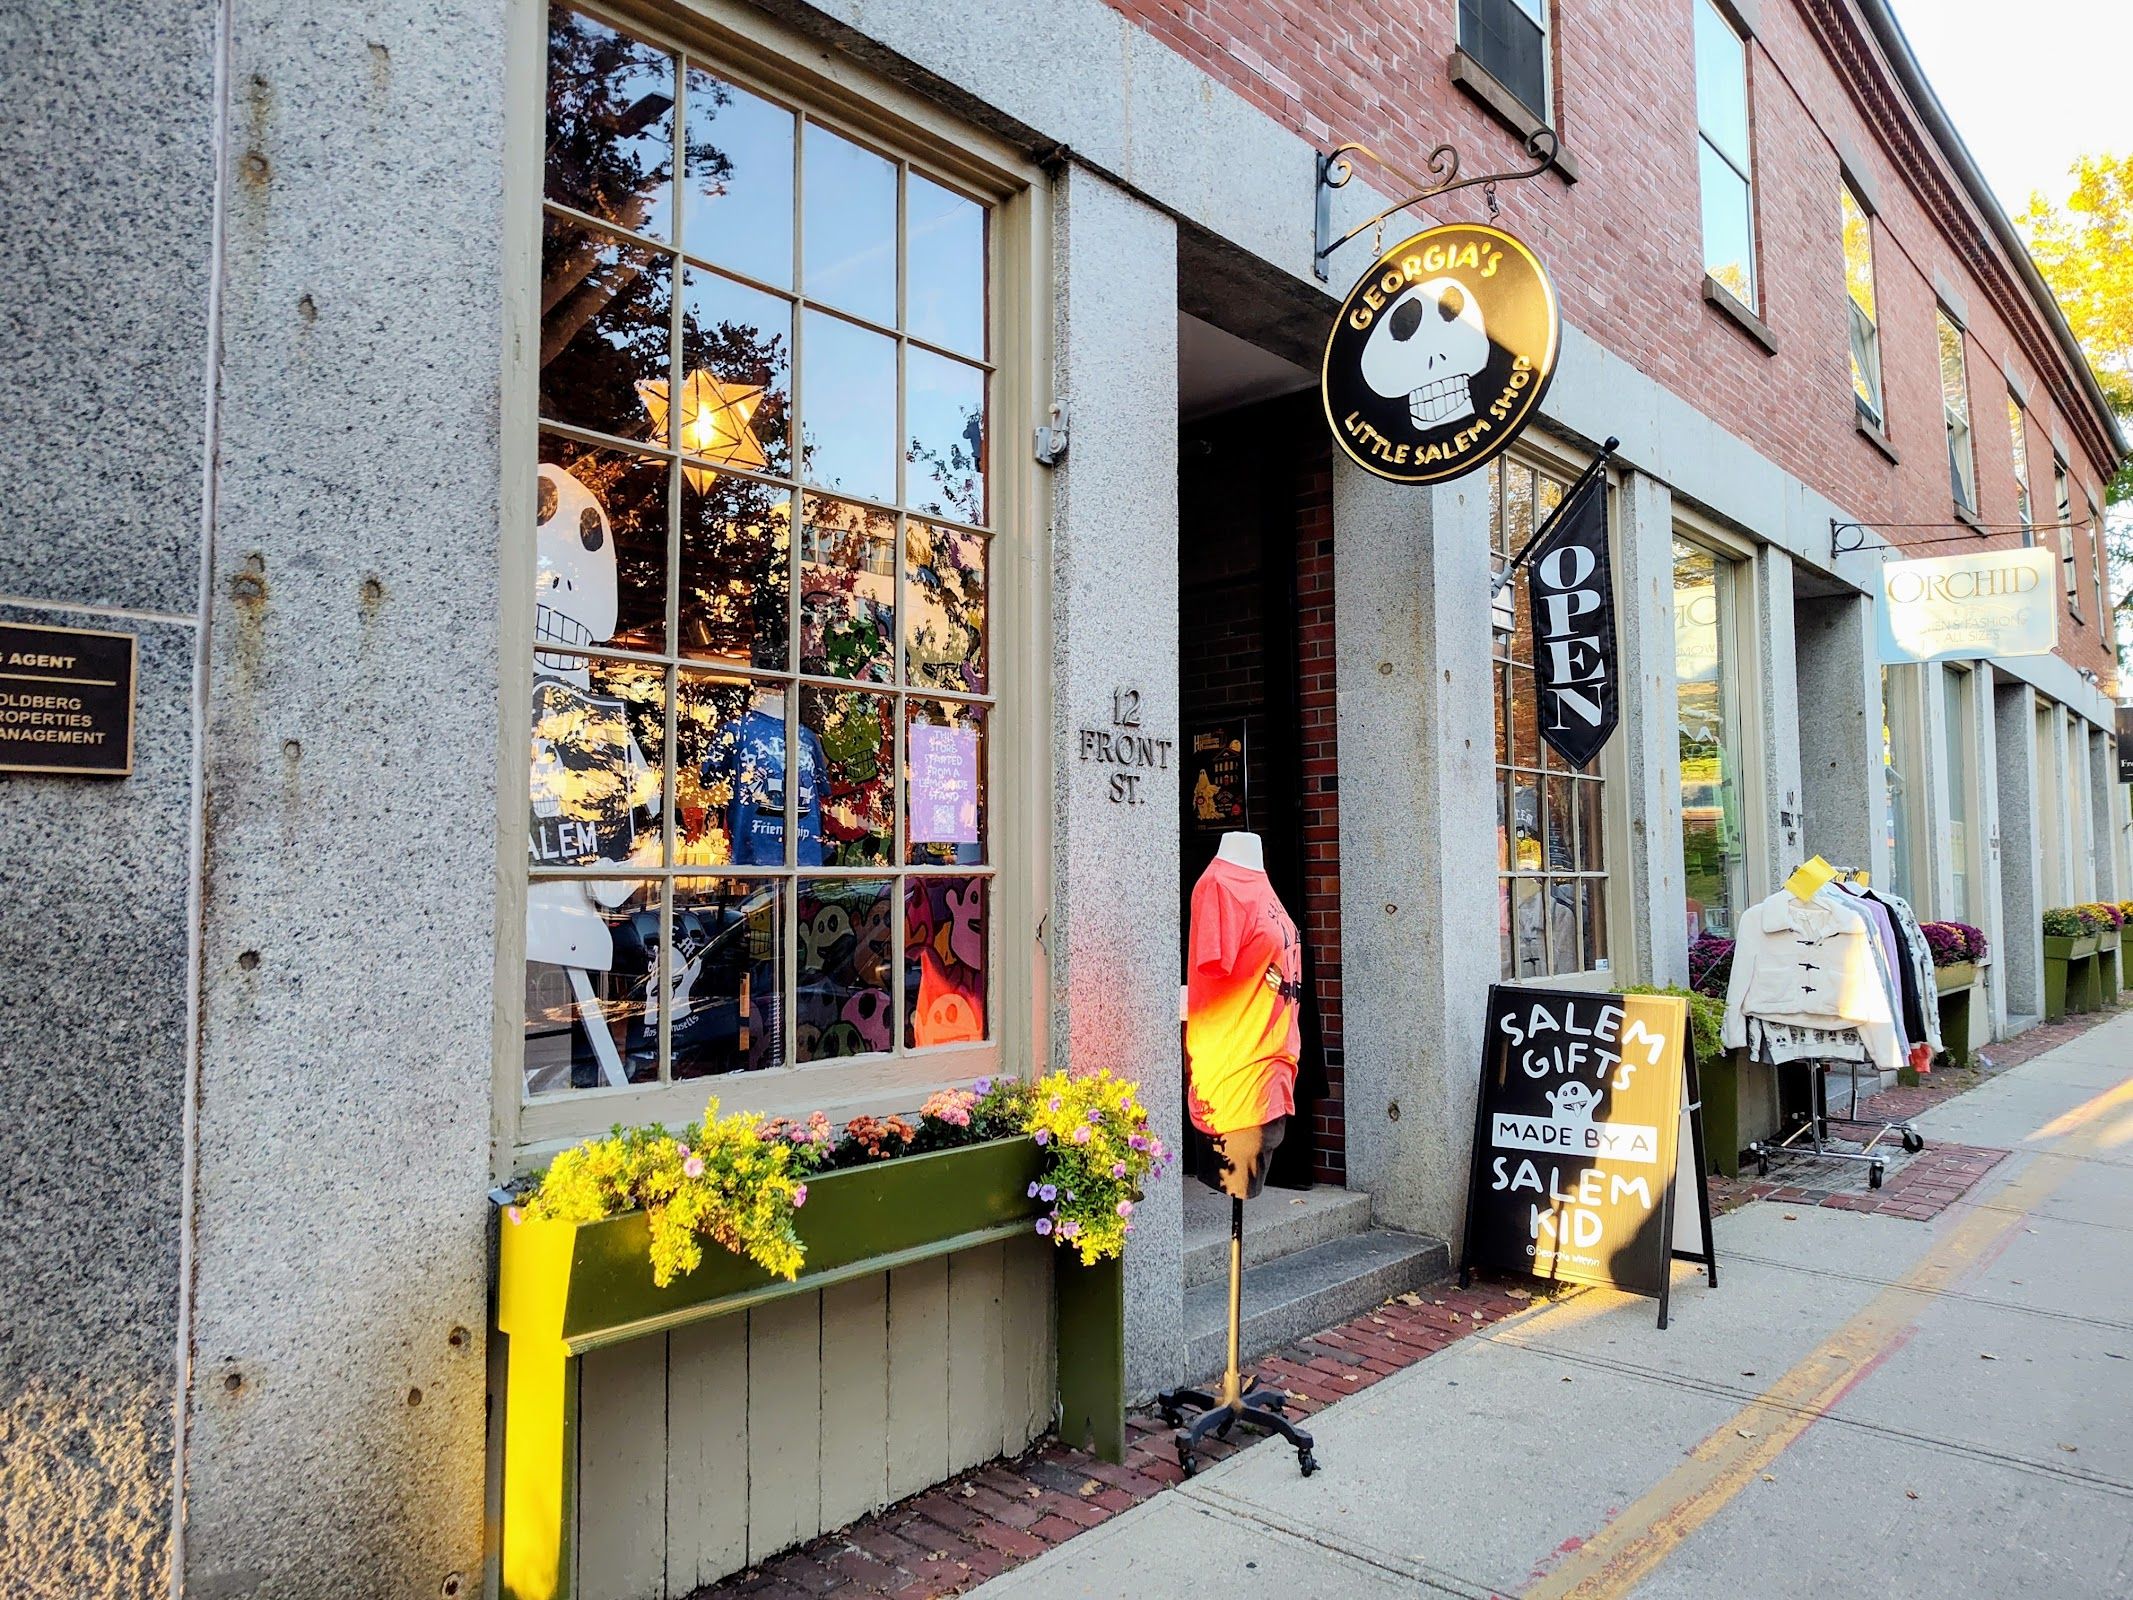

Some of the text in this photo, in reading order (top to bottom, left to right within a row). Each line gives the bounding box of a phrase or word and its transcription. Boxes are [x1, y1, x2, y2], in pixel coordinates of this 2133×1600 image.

[1350, 241, 1503, 330] GEORGIA'S
[1344, 354, 1533, 465] LITTLE SALEM SHOP
[1888, 566, 2040, 604] ORCHID
[1539, 545, 1608, 730] OPEN
[8, 652, 76, 670] AGENT
[1113, 686, 1141, 727] 12
[930, 743, 958, 754] STORE
[934, 730, 954, 742] THIS
[1079, 729, 1172, 769] FRONT
[924, 754, 963, 766] STARTED
[928, 766, 960, 778] FROM A
[919, 779, 968, 791] LEMODE
[929, 790, 960, 802] STAND
[1109, 772, 1145, 804] ST.
[528, 821, 598, 861] ALEM
[1500, 1002, 1666, 1065] SALEM
[1522, 1043, 1637, 1091] GIFTS
[1500, 1122, 1649, 1152] MADE BY A
[1491, 1156, 1652, 1209] SALEM
[1530, 1203, 1603, 1248] KID
